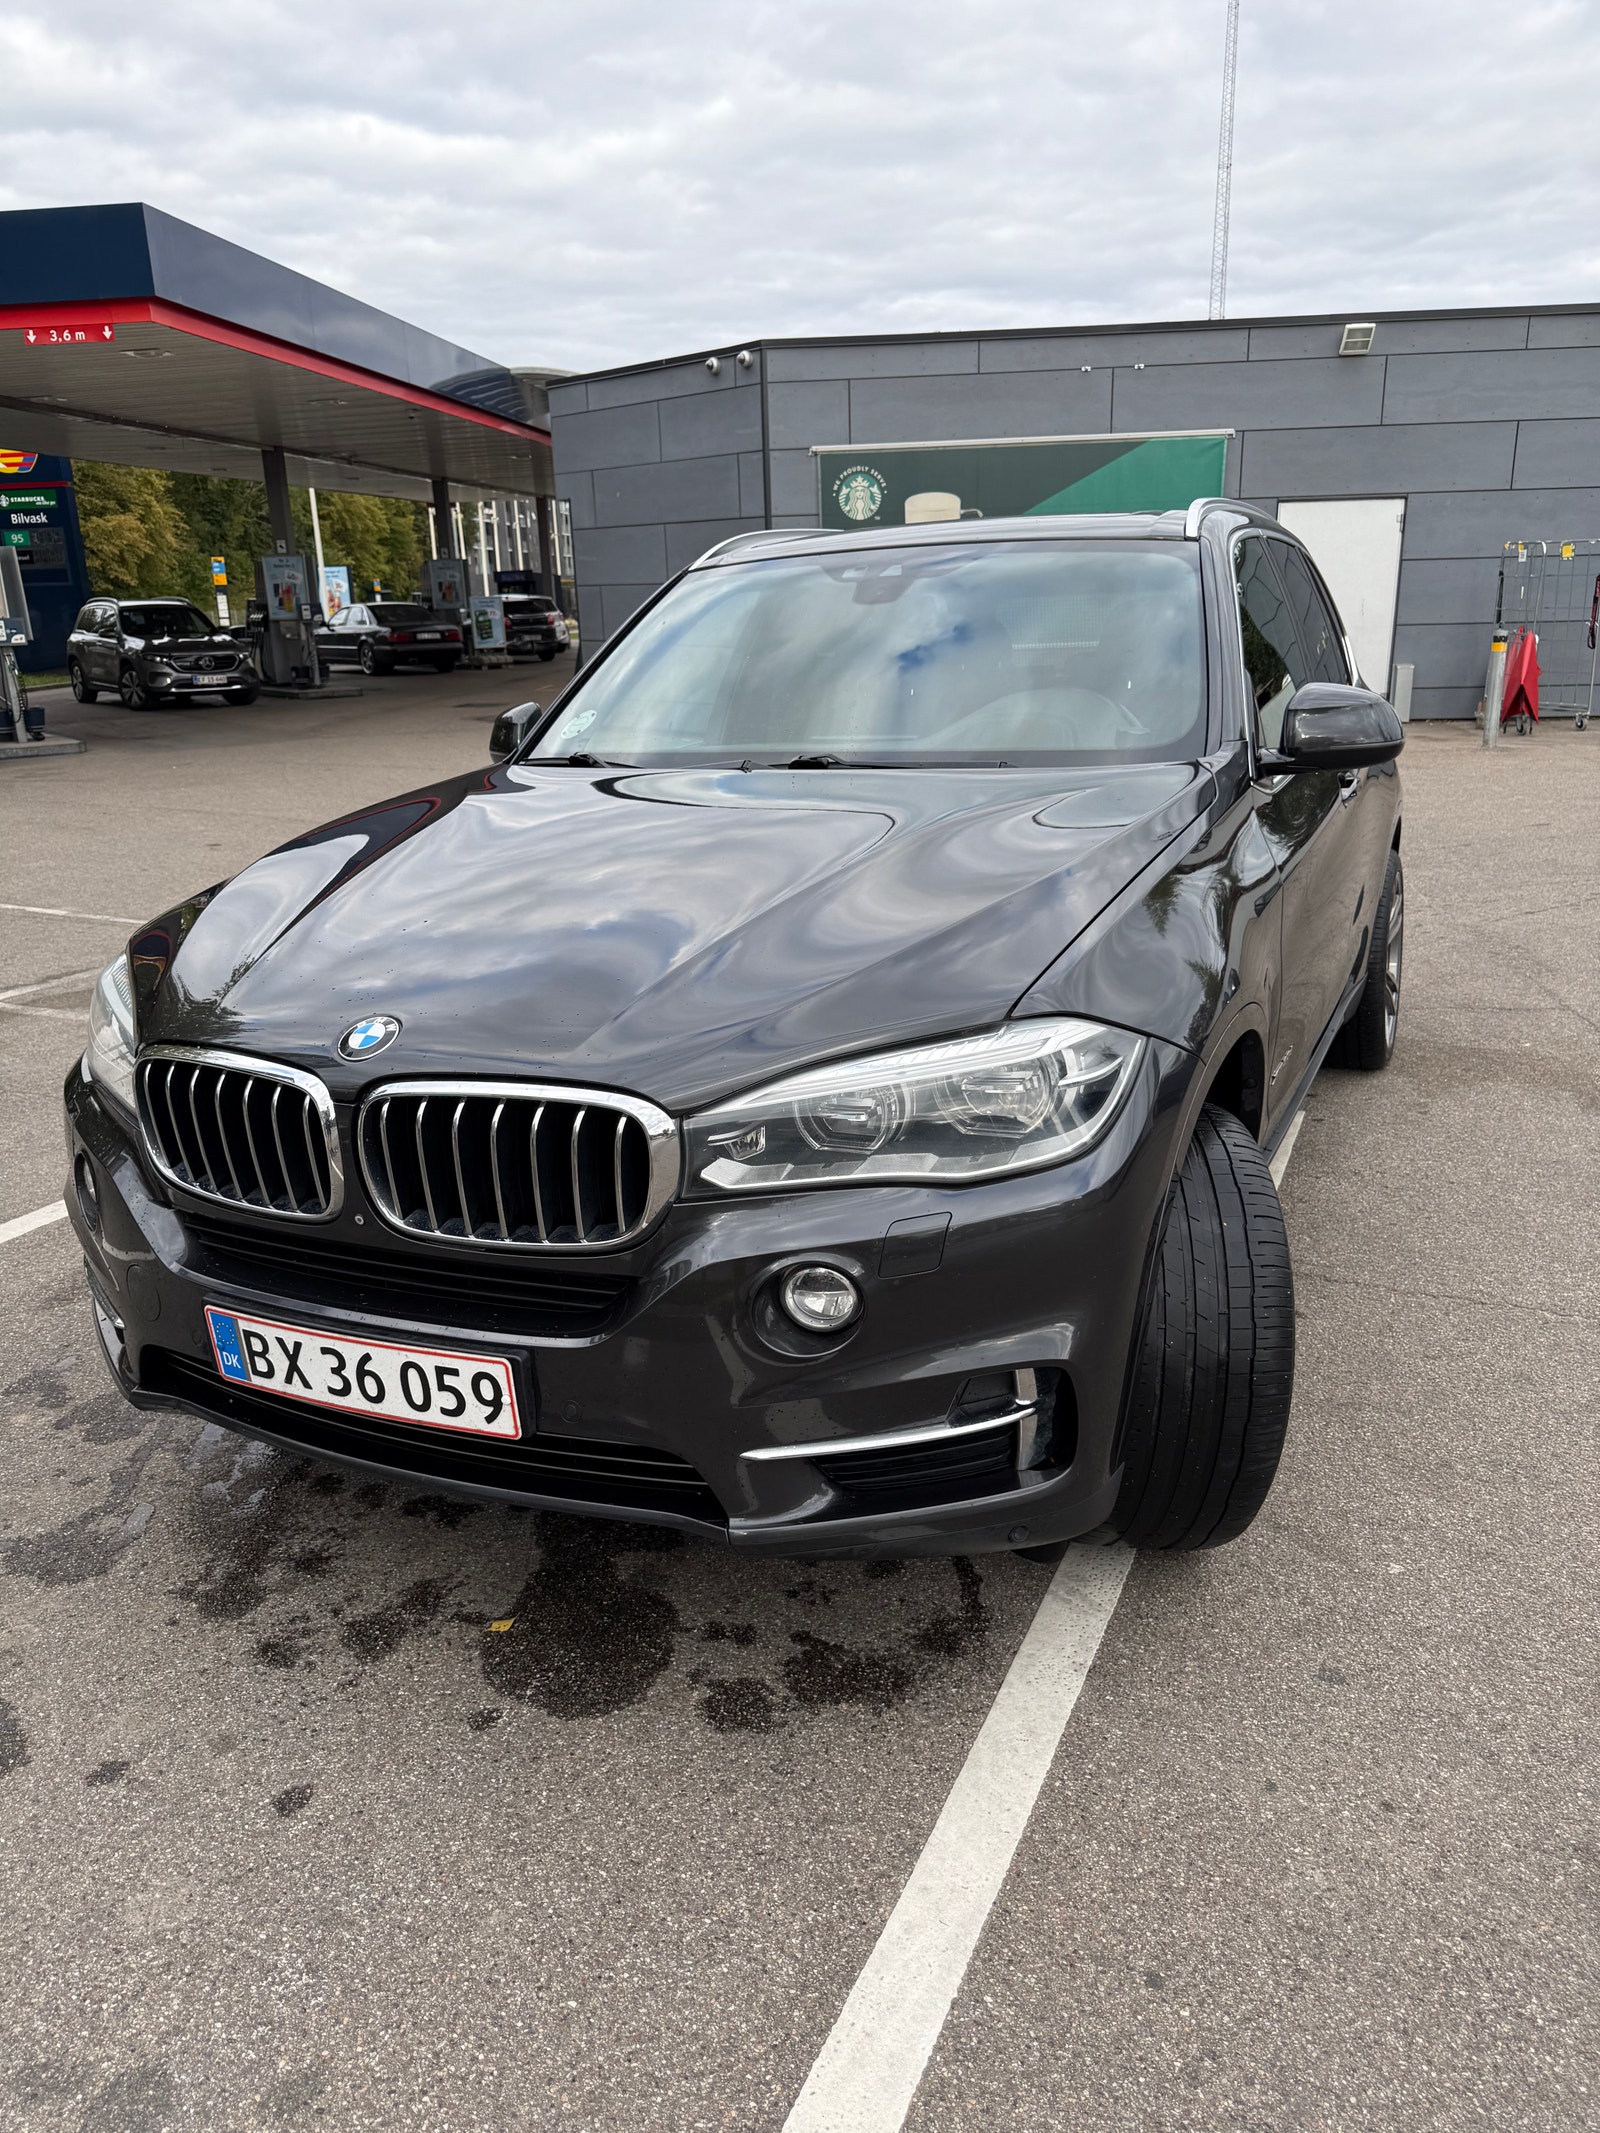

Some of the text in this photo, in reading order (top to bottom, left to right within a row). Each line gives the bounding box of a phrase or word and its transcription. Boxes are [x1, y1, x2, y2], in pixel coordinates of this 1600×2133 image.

[50, 330, 85, 343] 3,6 m
[833, 466, 887, 490] WE PROUDLY SERVE
[10, 512, 48, 525] Bilvask
[11, 533, 24, 544] 95
[222, 1351, 242, 1369] DK
[242, 1329, 504, 1425] BX 36 059
